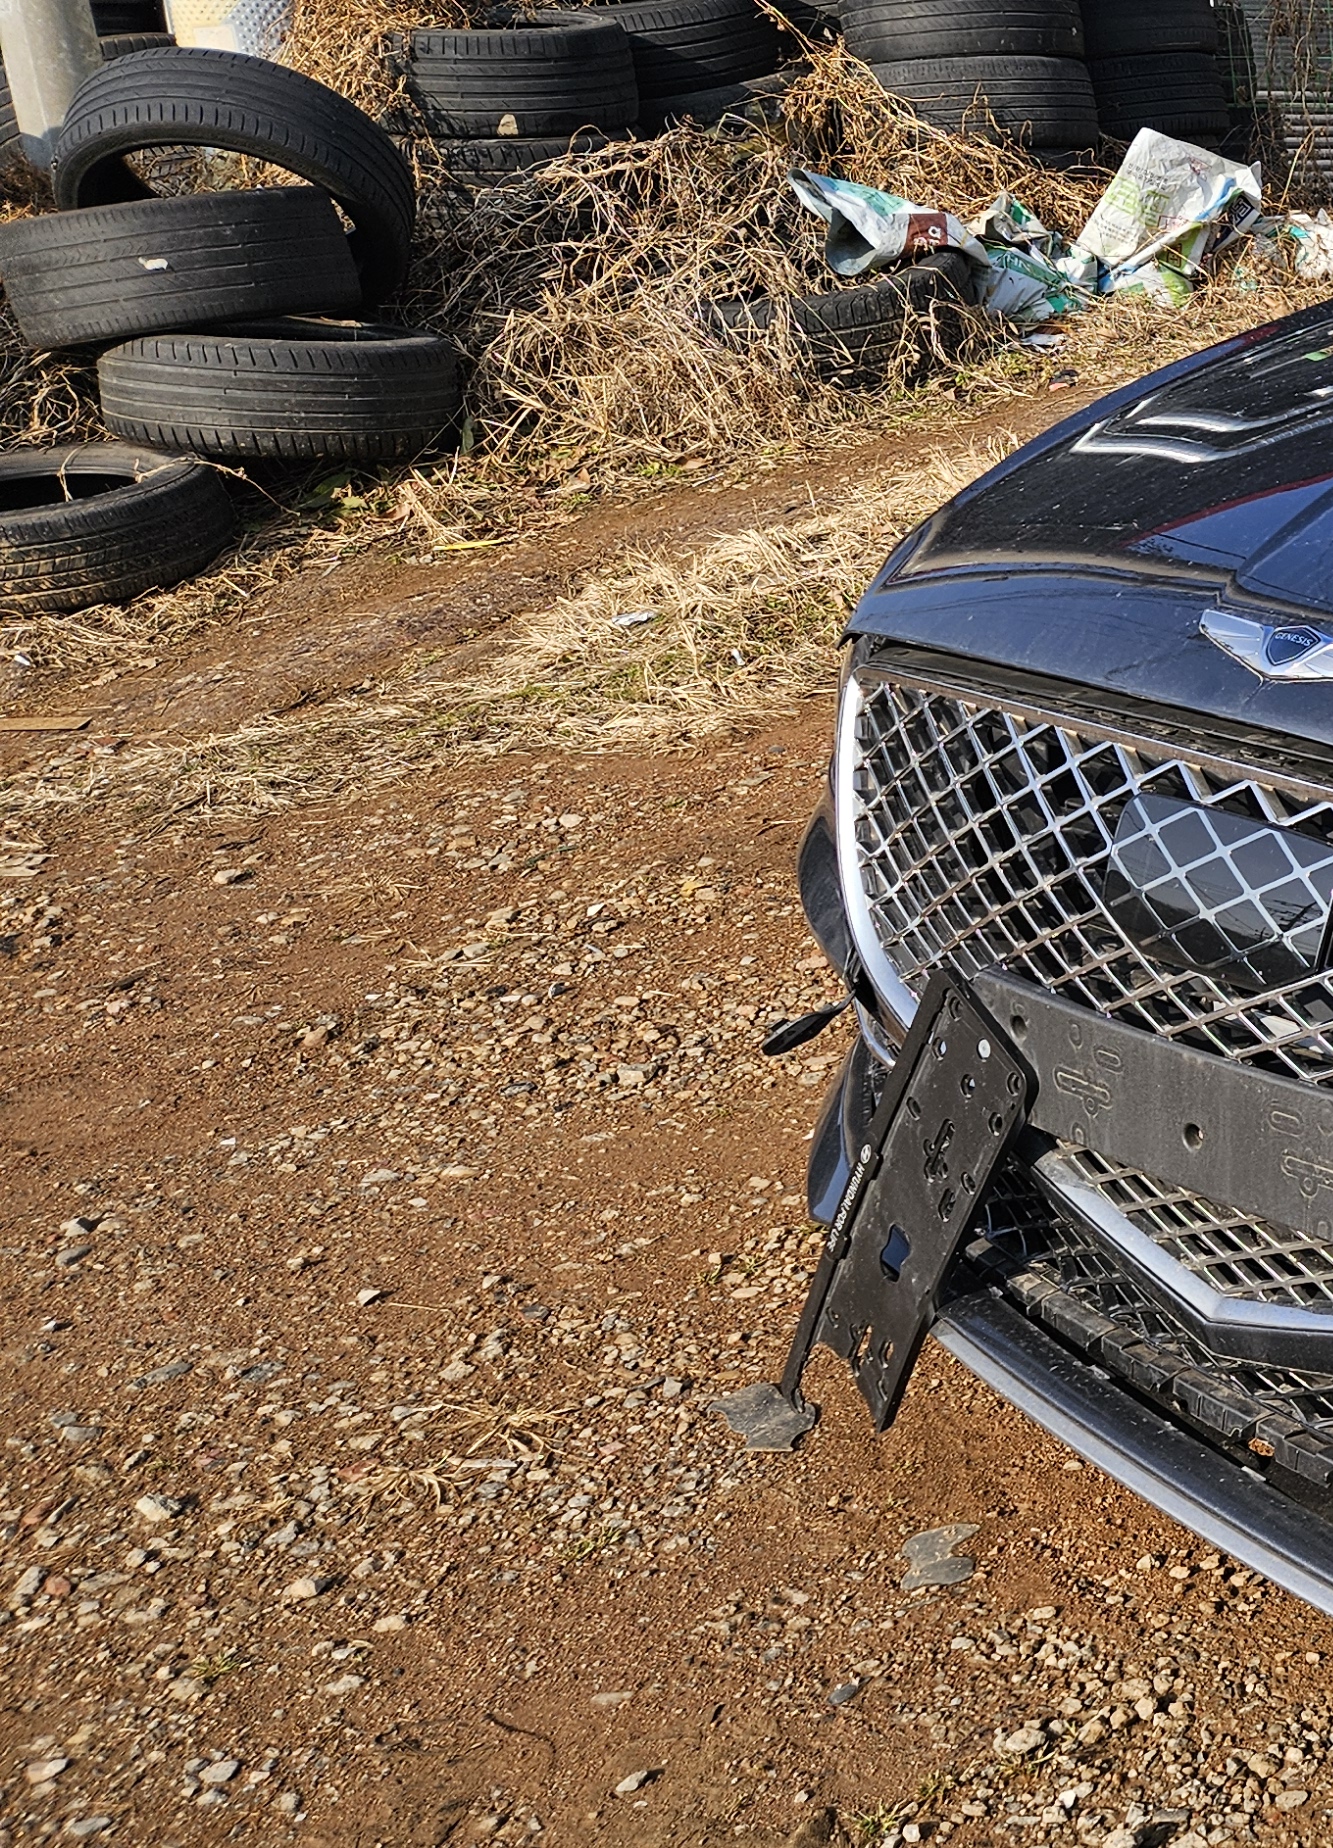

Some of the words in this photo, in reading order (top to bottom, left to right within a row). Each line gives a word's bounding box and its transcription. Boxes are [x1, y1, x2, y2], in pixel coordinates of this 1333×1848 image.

[1275, 632, 1313, 646] GENESIS
[841, 1161, 866, 1211] HYUNDAI
[834, 1208, 848, 1230] FOR
[826, 1229, 840, 1253] LIFE
